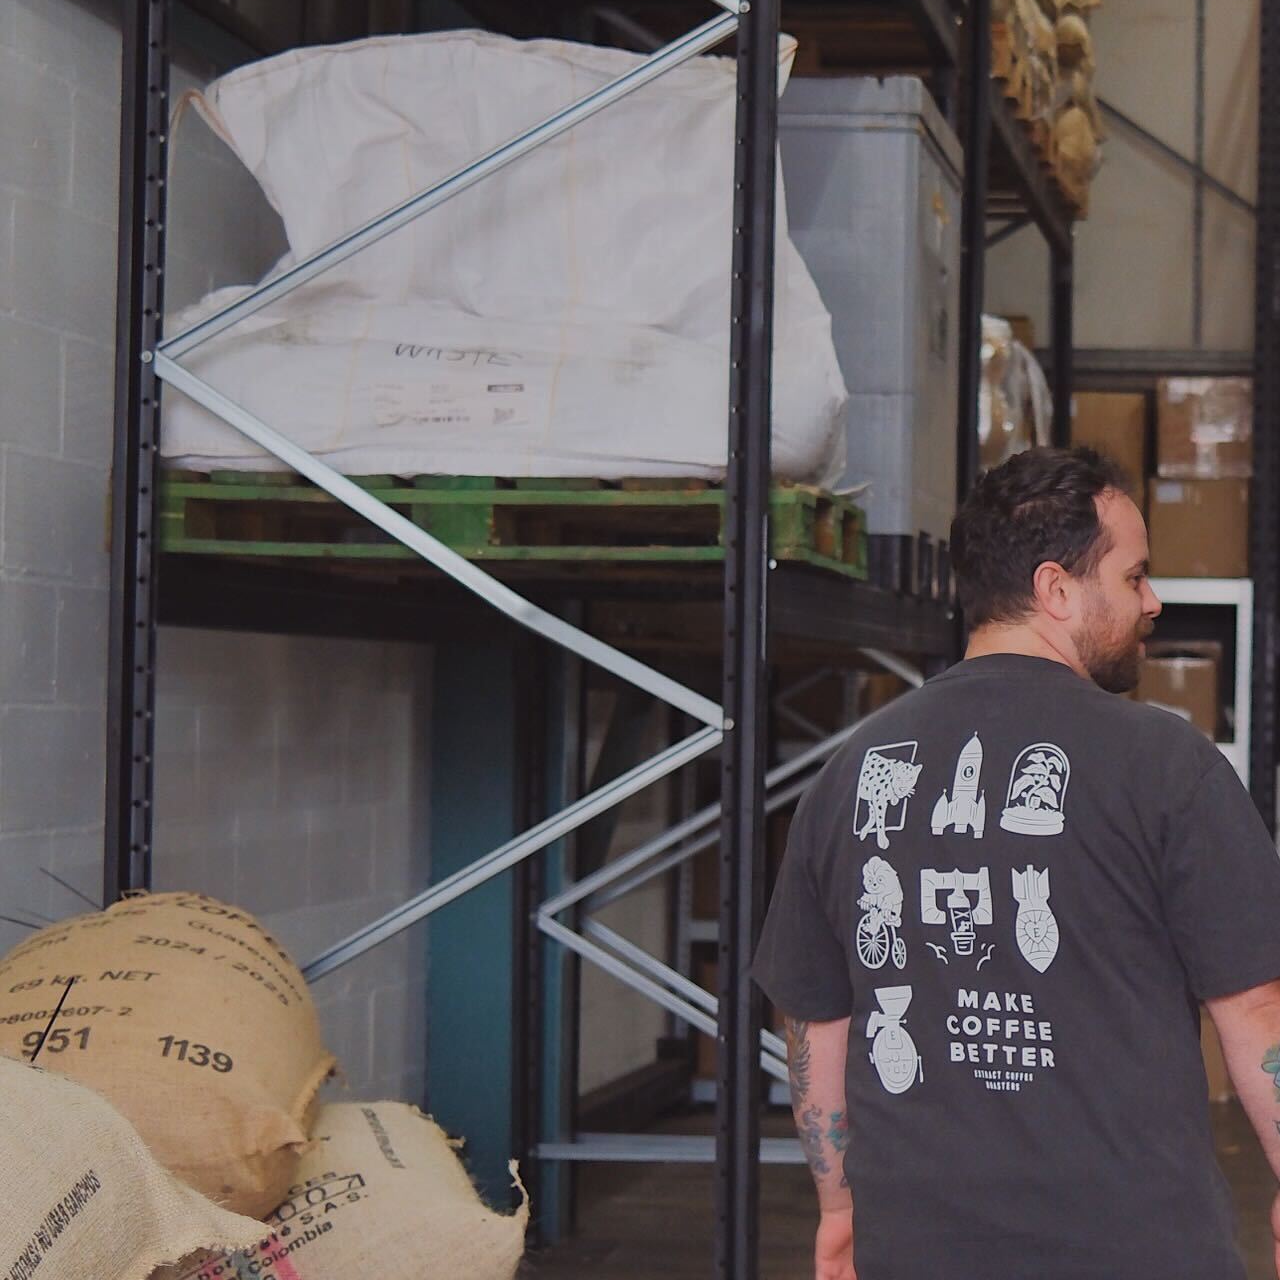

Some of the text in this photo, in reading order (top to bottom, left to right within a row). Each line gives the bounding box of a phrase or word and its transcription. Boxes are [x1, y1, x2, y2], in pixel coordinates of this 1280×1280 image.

[133, 935, 207, 956] 2024
[99, 970, 160, 982] NET
[957, 988, 1034, 1013] MAKE
[946, 1015, 1052, 1041] COFFEE
[21, 1026, 92, 1058] 951
[158, 1034, 234, 1074] 1139
[950, 1042, 1055, 1068] BETTER
[1005, 1071, 1033, 1082] COFFEE
[247, 1220, 333, 1274] Colombia
